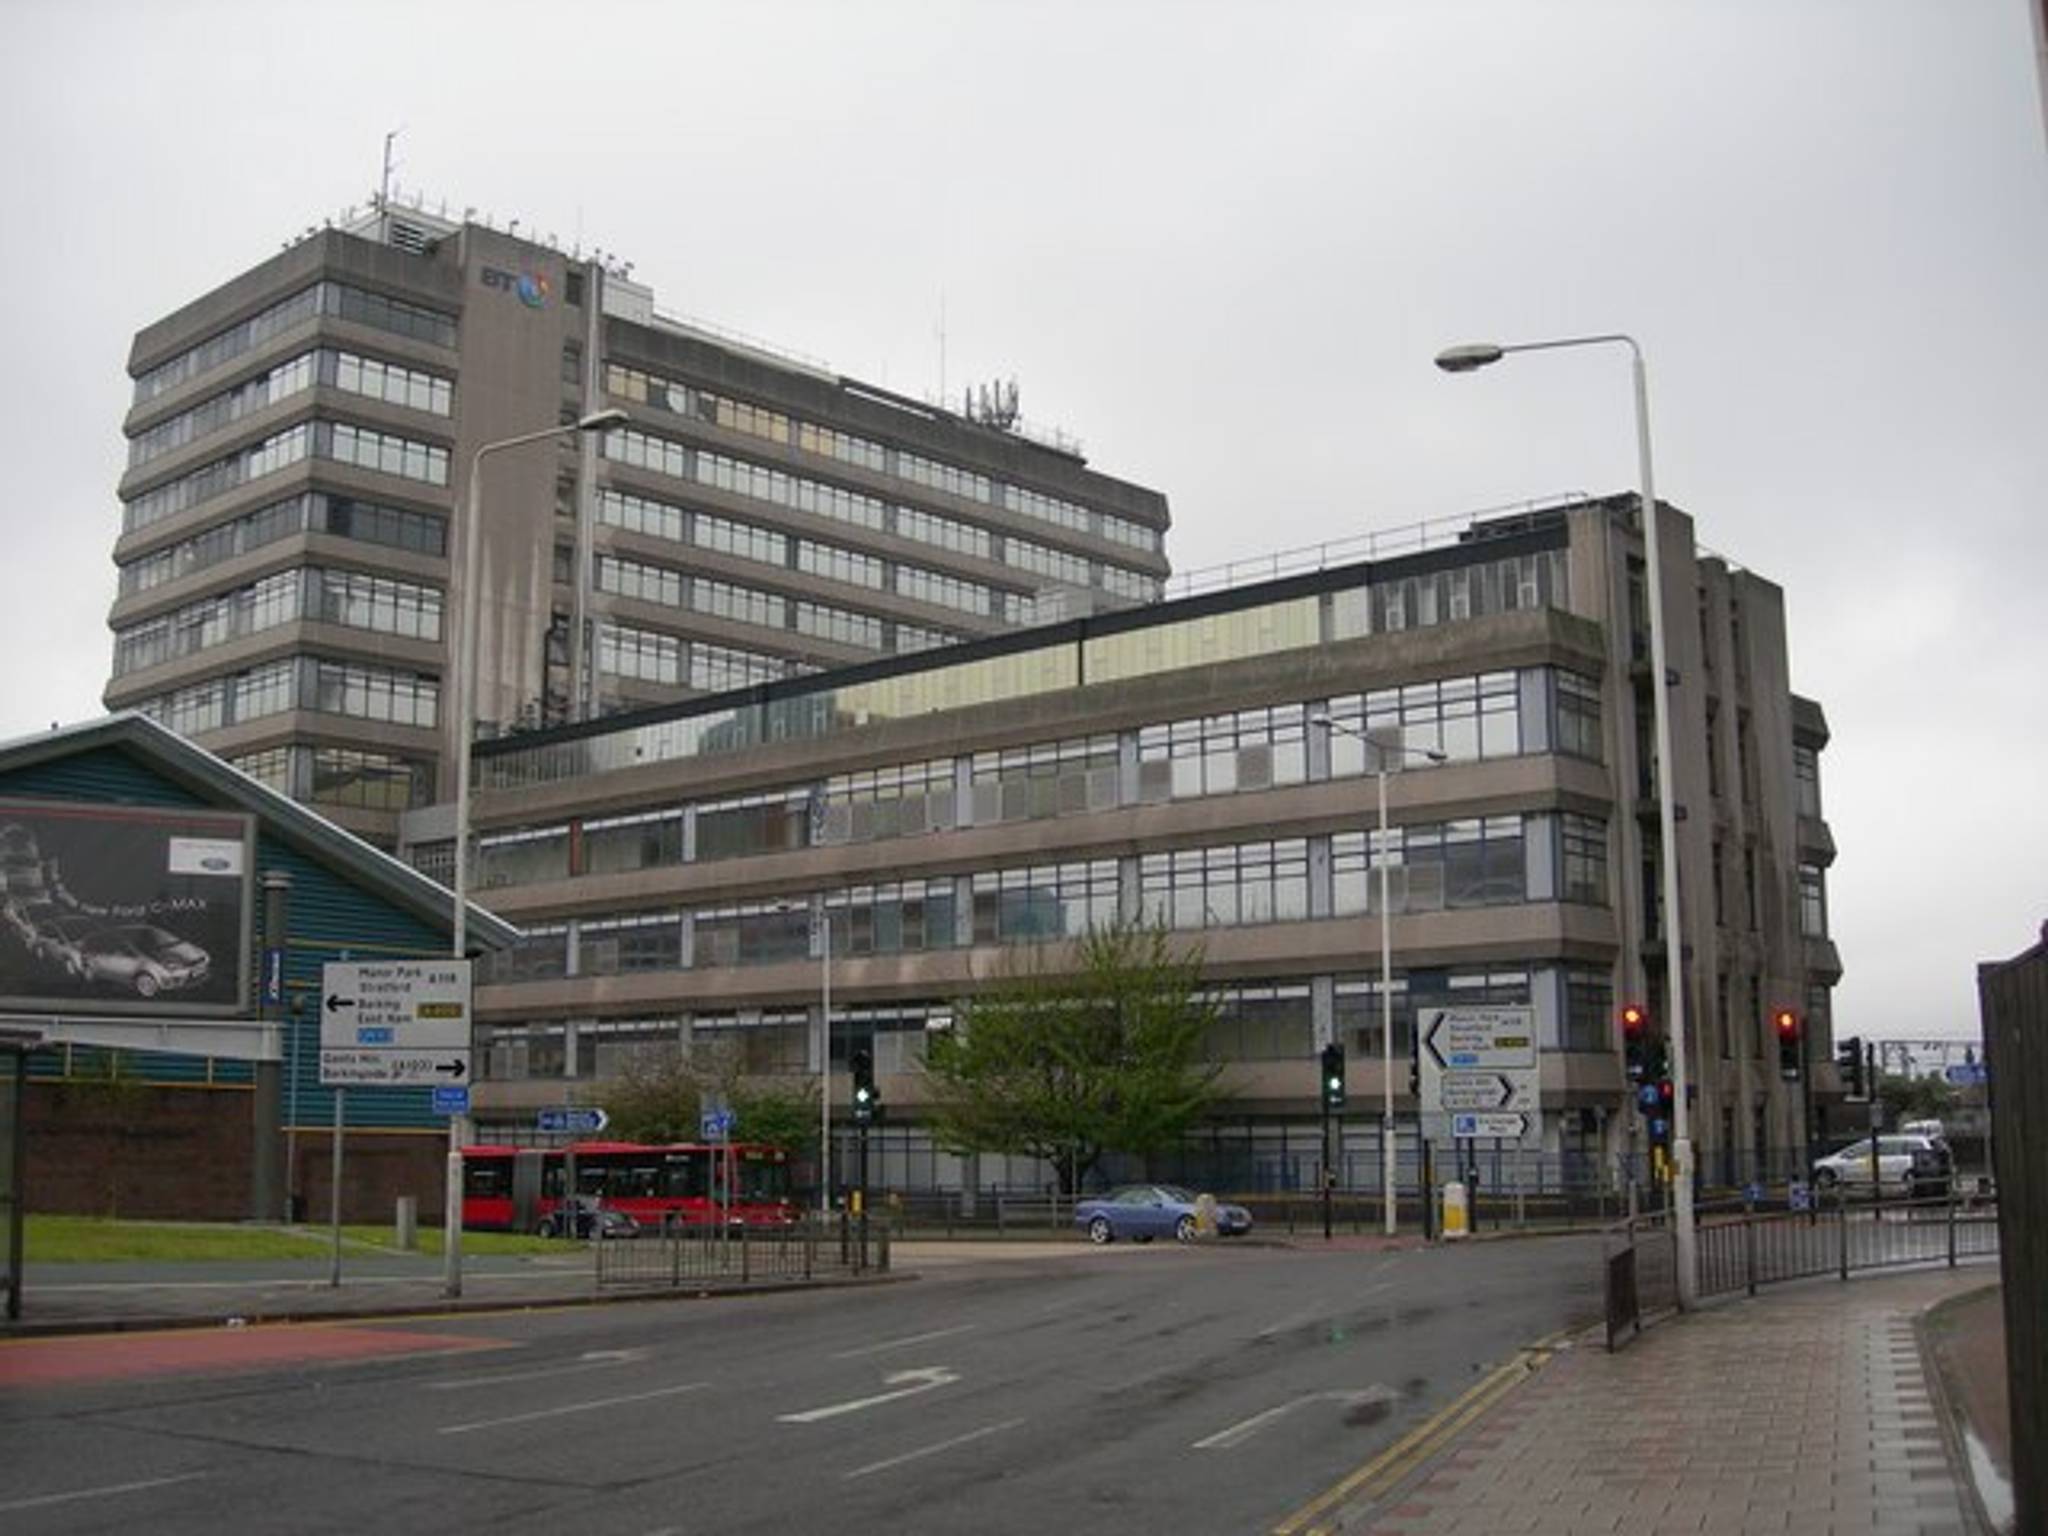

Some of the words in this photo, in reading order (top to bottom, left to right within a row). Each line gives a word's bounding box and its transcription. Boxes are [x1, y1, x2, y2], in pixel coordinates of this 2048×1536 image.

[482, 266, 515, 292] BT
[113, 904, 145, 917] Ford
[397, 967, 421, 978] Park
[358, 1014, 383, 1024] East
